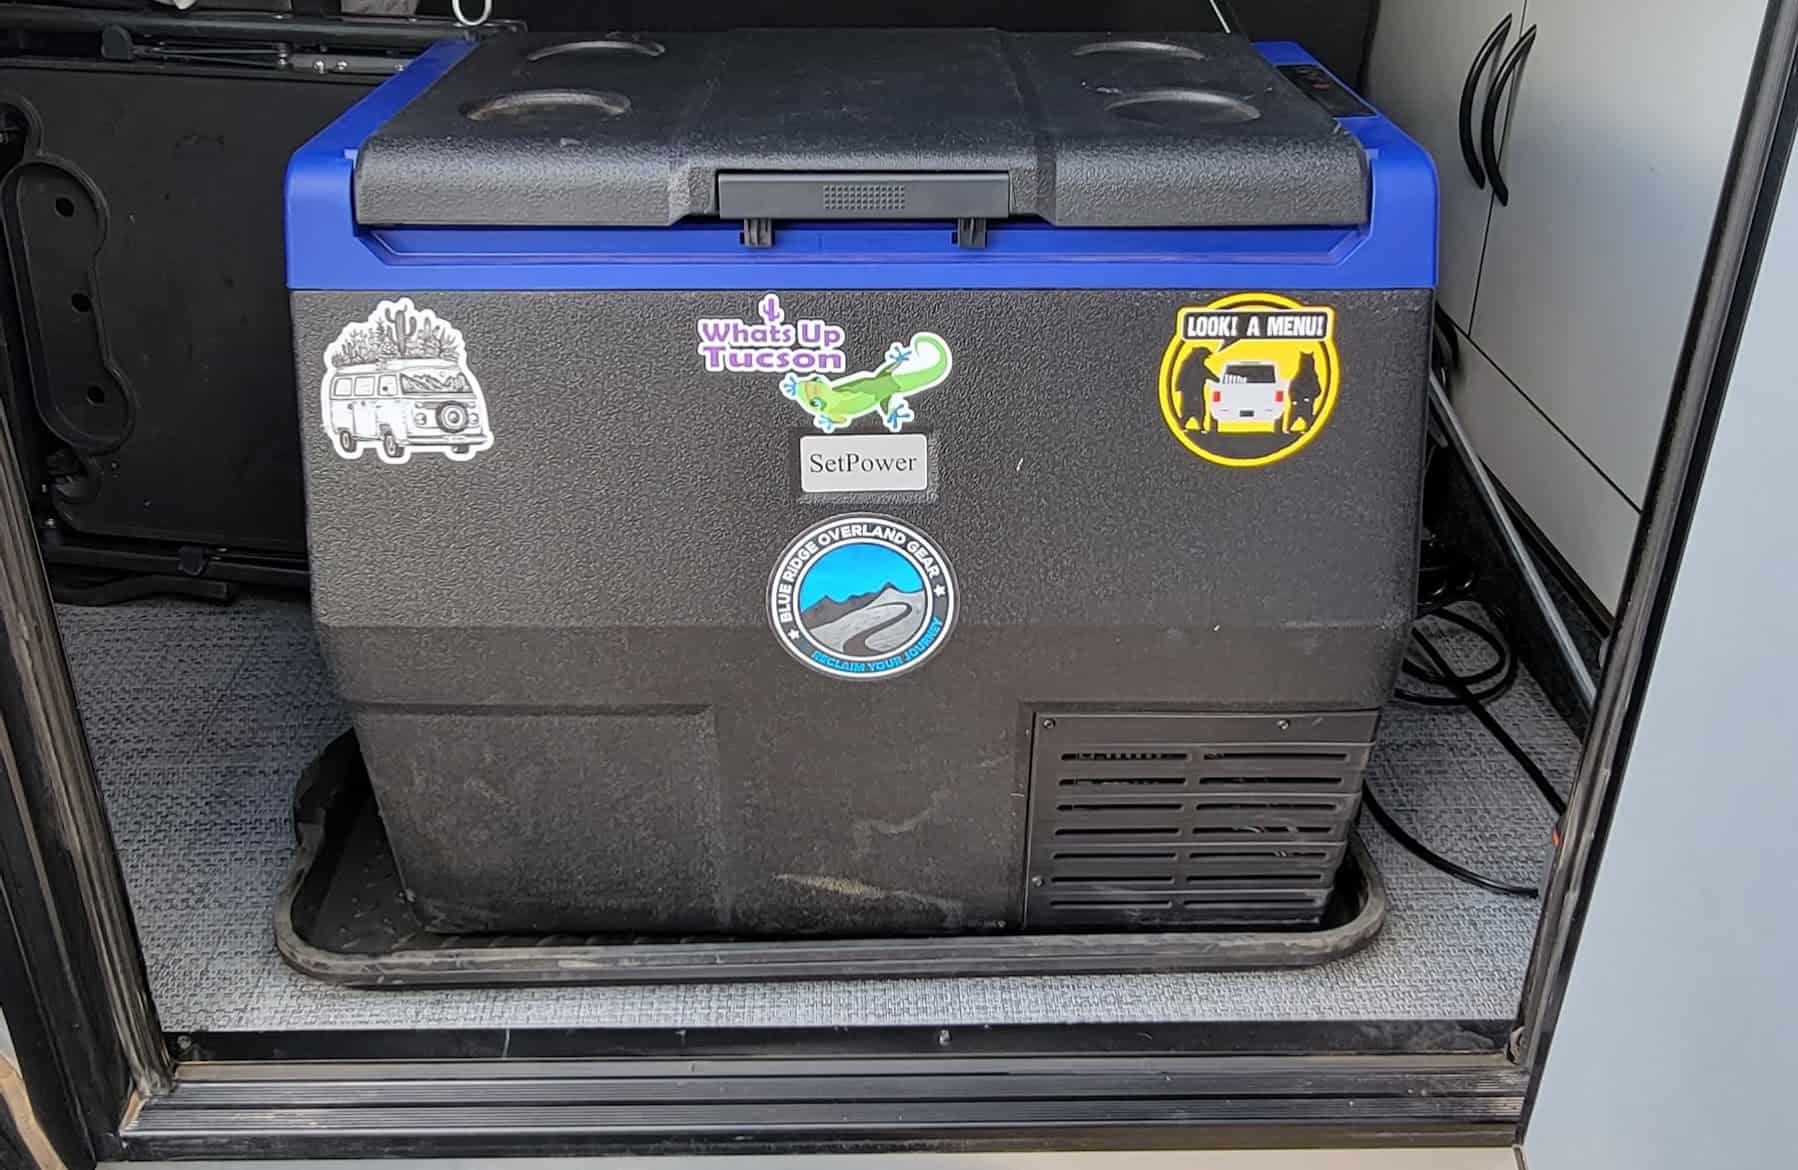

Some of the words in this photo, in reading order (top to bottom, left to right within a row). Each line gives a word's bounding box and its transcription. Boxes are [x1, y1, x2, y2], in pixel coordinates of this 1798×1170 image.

[701, 323, 791, 343] Whats
[802, 323, 841, 347] Up
[1246, 316, 1260, 337] A
[703, 346, 842, 369] Tucson
[809, 453, 917, 473] SetPower
[818, 524, 907, 546] OVERLAND
[782, 541, 817, 582] RIDGE
[906, 541, 940, 578] GEAR
[778, 583, 793, 623] BLUE
[811, 650, 865, 672] RECLAIM
[869, 655, 903, 672] YOUR
[902, 616, 943, 661] JOURNEY
